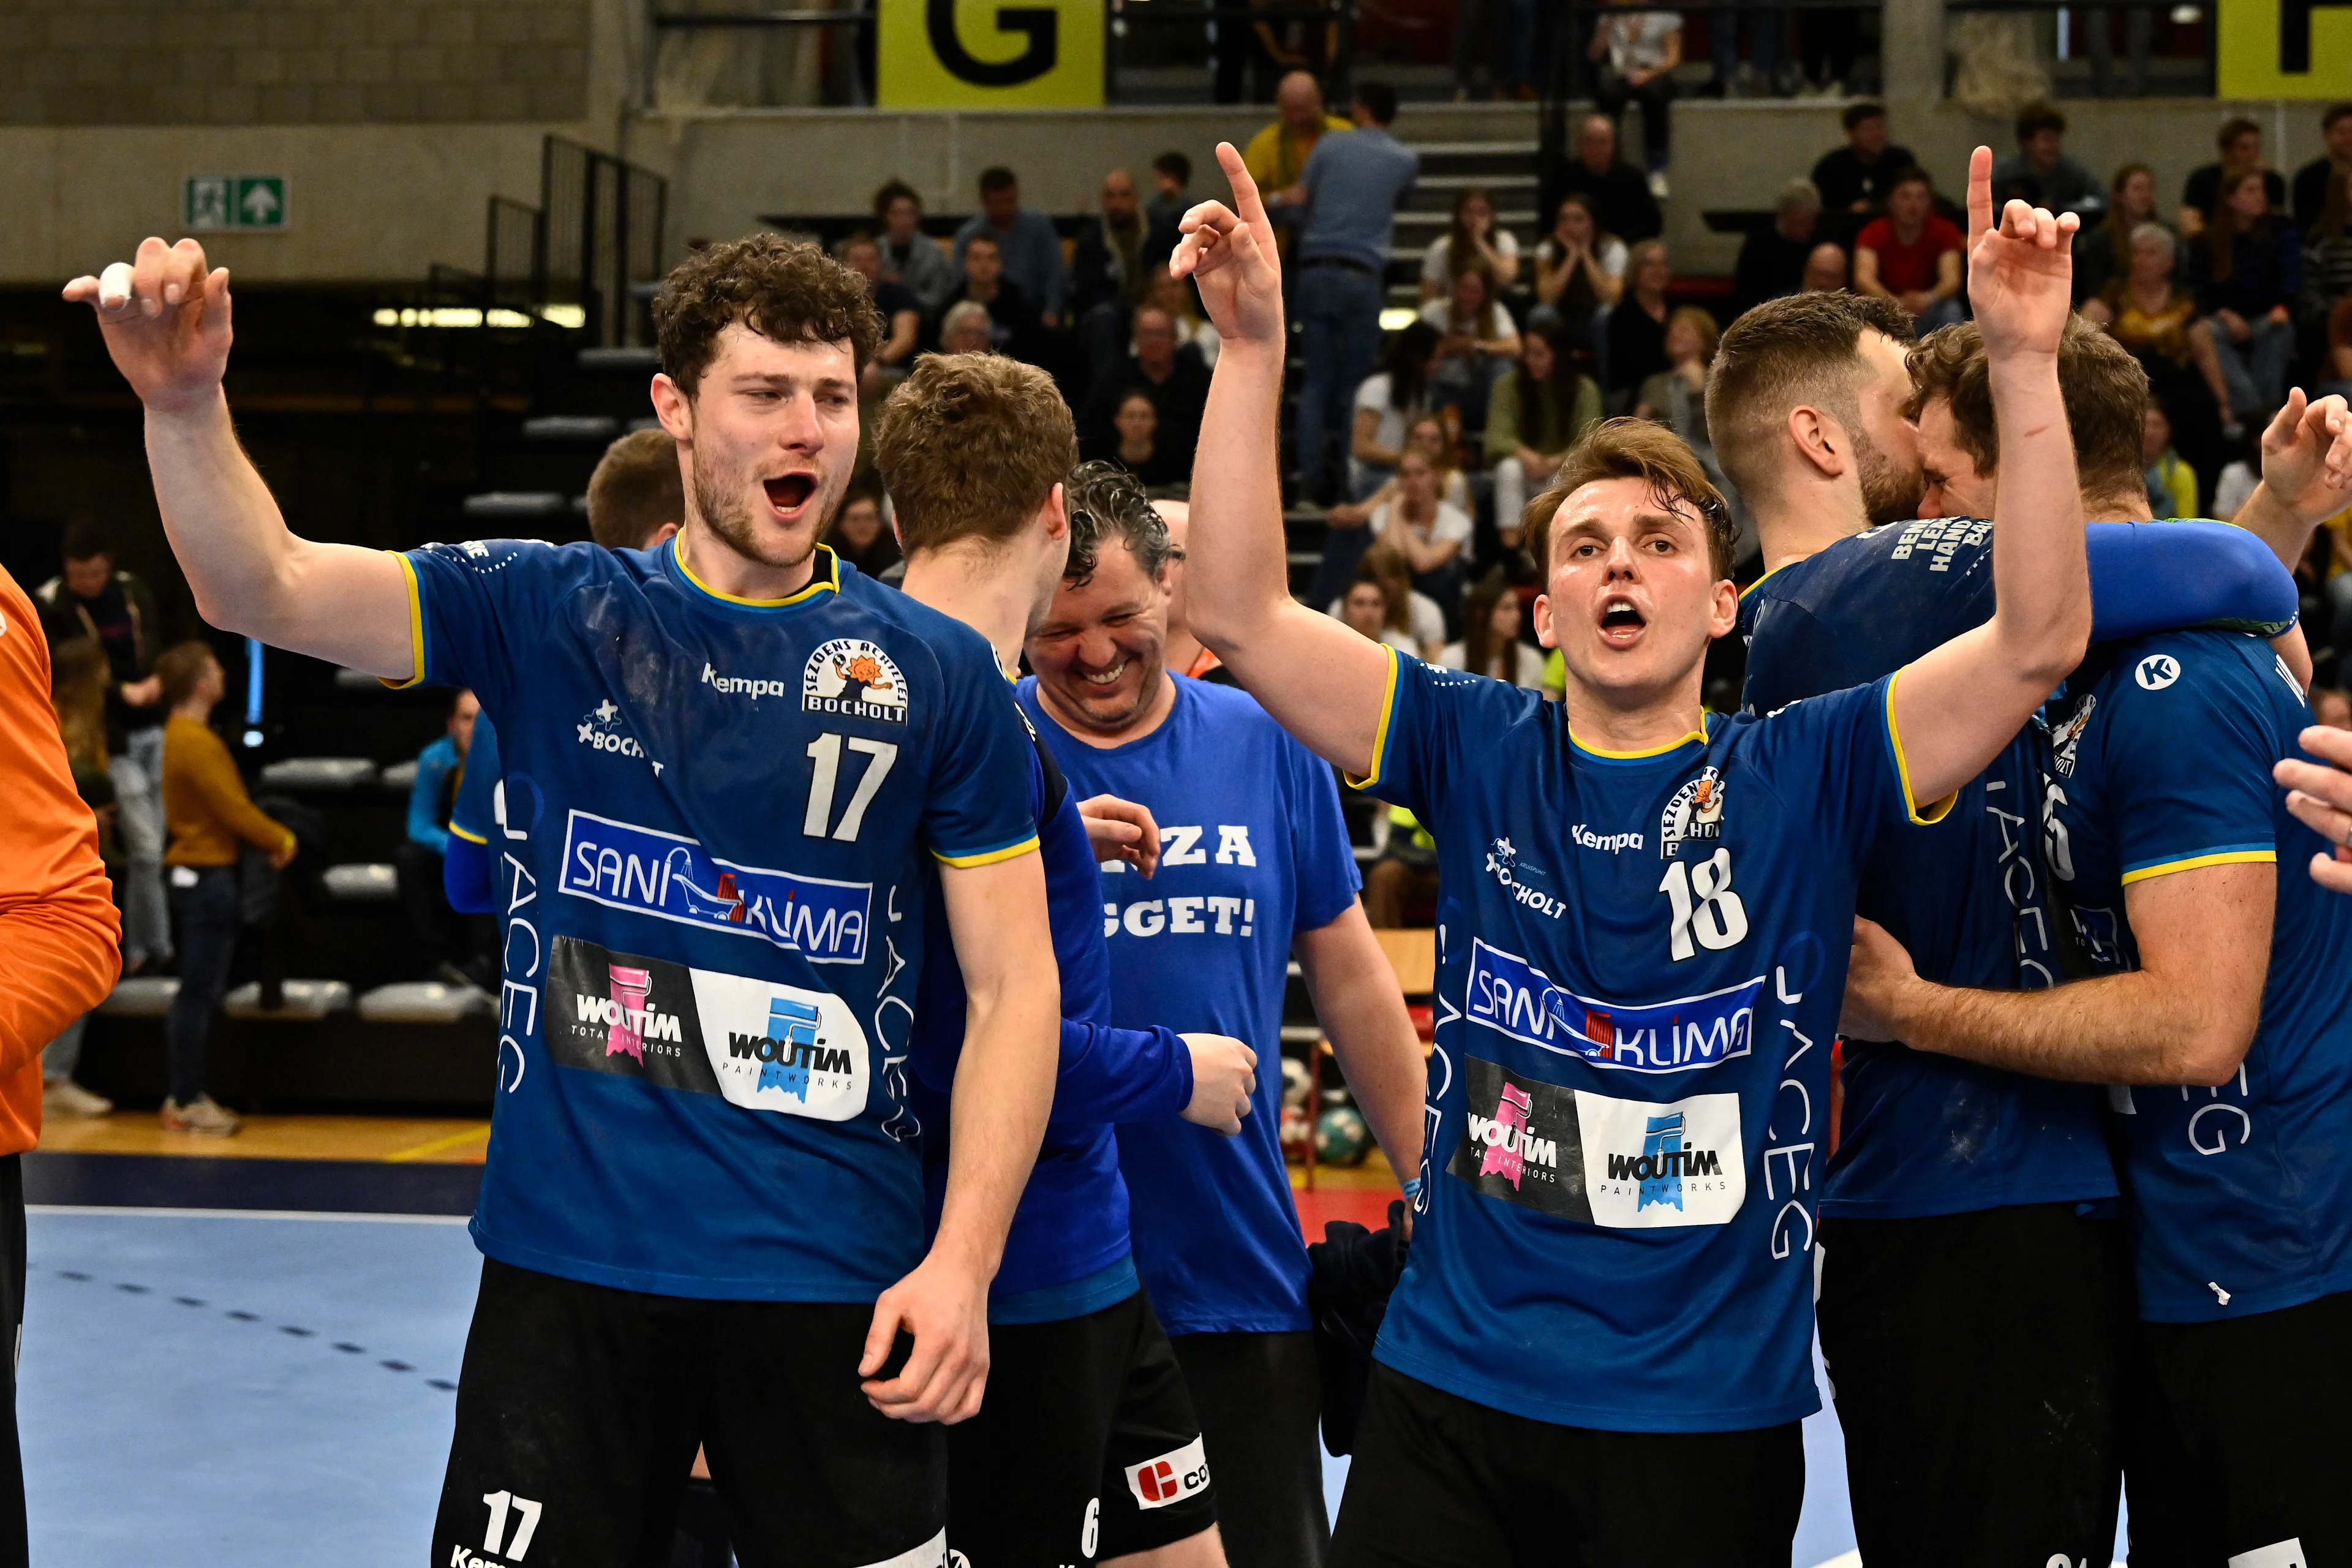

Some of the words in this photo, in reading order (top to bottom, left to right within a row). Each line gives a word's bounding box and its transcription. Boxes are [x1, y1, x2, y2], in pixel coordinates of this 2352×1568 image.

[1929, 520, 1972, 572] HAND
[701, 662, 785, 700] Kempa
[805, 640, 851, 692] SEZOENS
[859, 642, 907, 705] ACHILLES
[808, 696, 905, 722] BOCHOLT
[593, 731, 665, 778] BOCHT
[804, 732, 898, 842] 17
[1663, 780, 1700, 838] SEZOEN
[1571, 824, 1644, 855] Kempa
[573, 841, 672, 907] SANI
[1659, 848, 1749, 962] 18
[571, 1025, 613, 1041] TOTAL
[621, 1033, 681, 1058] INTERIORS
[722, 1062, 853, 1090] PAINTWORKS
[1498, 1155, 1556, 1183] INTERIORS
[1600, 1182, 1726, 1196] PAINTWORKS
[483, 1489, 543, 1562] 17
